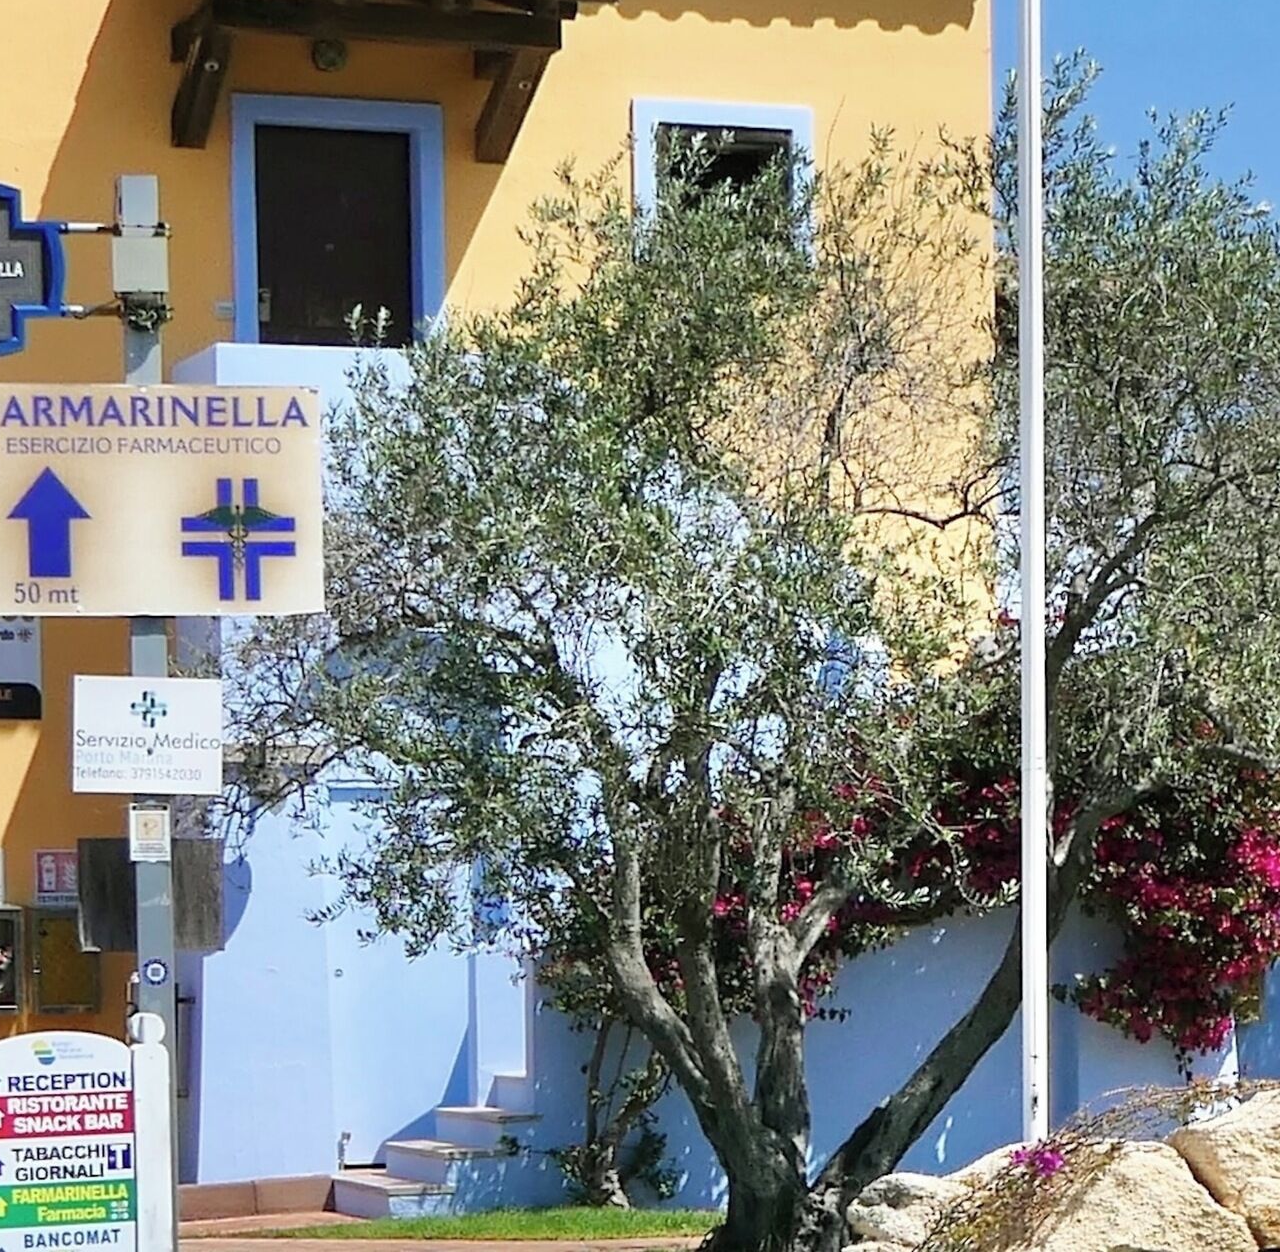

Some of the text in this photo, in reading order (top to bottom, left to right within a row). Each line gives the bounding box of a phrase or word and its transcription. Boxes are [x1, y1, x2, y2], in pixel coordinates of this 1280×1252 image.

[6, 437, 282, 455] ESERCIZIO FARMACEUTICO
[14, 582, 79, 604] 50 mt
[76, 729, 220, 749] Servizio Medico
[7, 1071, 127, 1092] RECEPTION
[7, 1093, 128, 1115] RISTORANTE
[13, 1113, 124, 1134] SNACK BAR
[12, 1144, 106, 1162] TABACCHI
[15, 1163, 104, 1182] GIORNALI
[12, 1183, 128, 1205] FARMARINELLA
[37, 1203, 106, 1223] Farmacia
[23, 1229, 121, 1249] BANCOMAT
